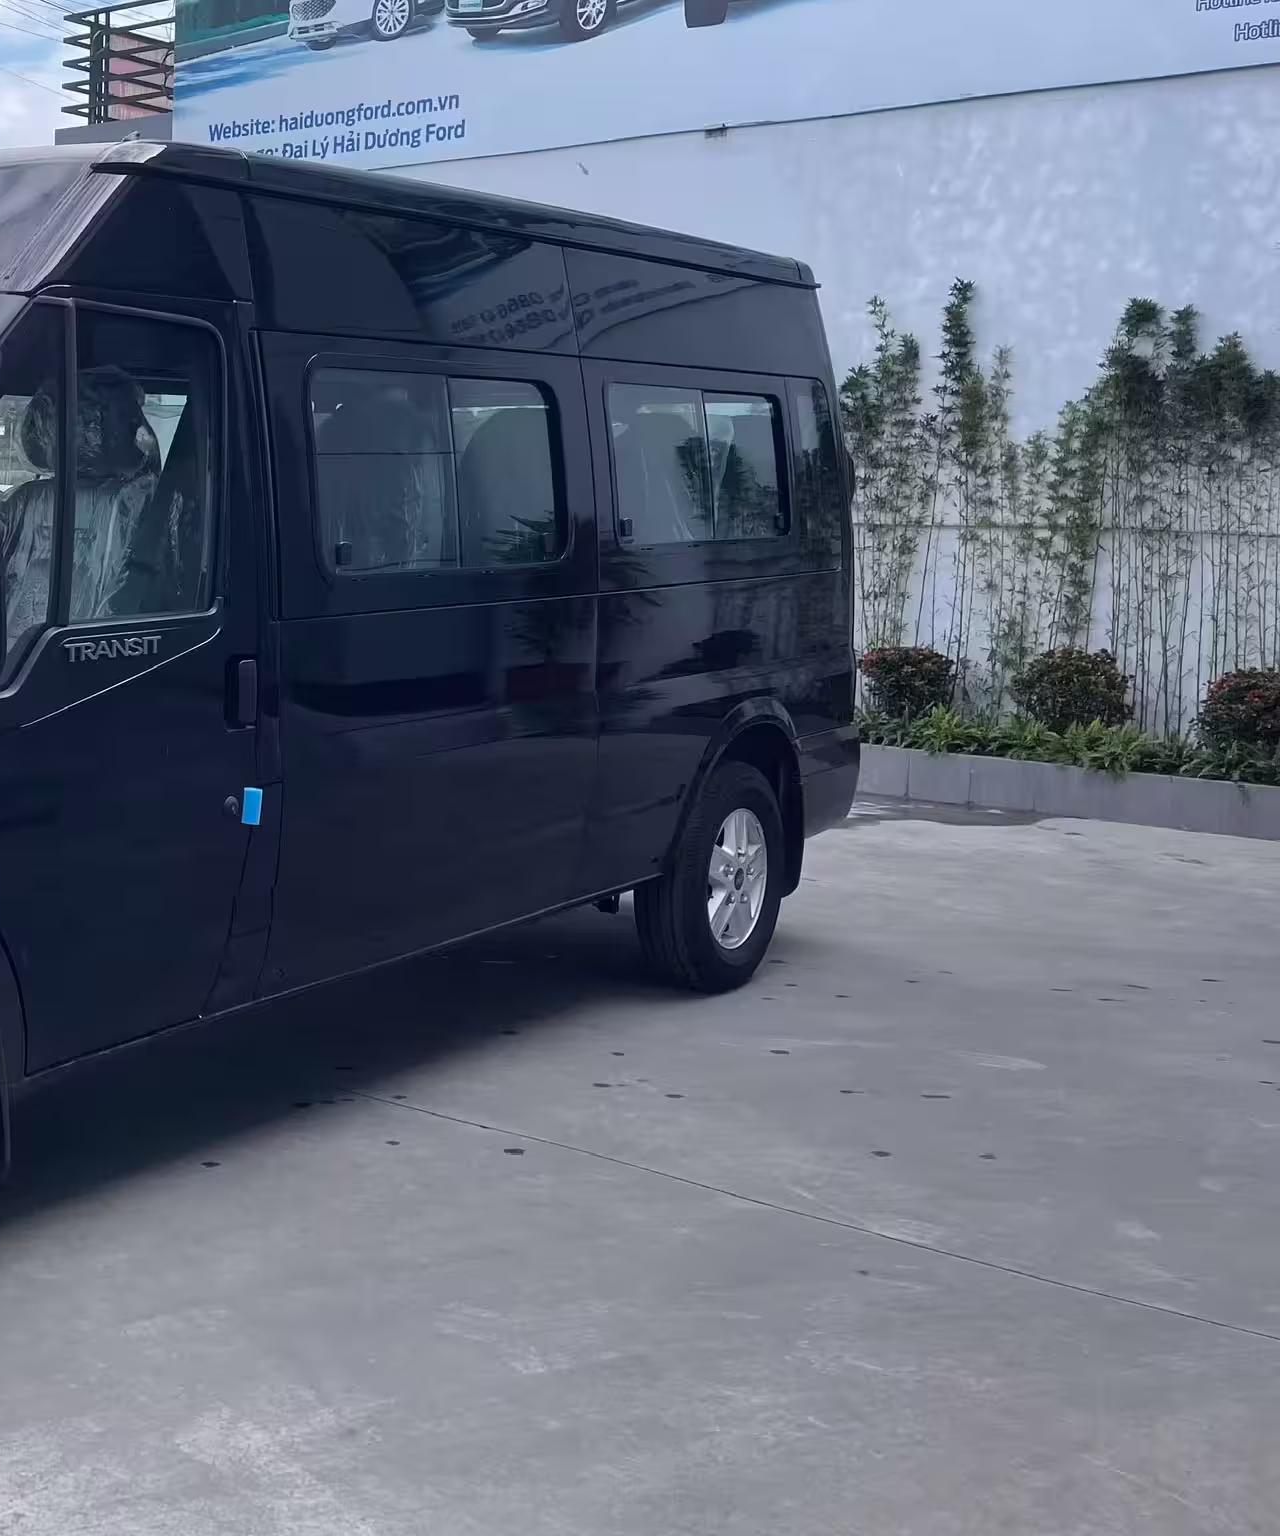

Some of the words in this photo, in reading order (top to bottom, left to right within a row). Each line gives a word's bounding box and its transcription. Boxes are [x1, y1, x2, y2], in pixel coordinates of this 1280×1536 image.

[1234, 18, 1280, 41] Hotli
[208, 120, 276, 142] Website:
[278, 94, 460, 133] haiduongford.com.vn
[312, 136, 330, 159] Lý
[333, 130, 361, 155] Hải
[364, 127, 421, 150] Dương
[425, 119, 466, 143] Ford
[63, 635, 162, 663] TRANSIT
